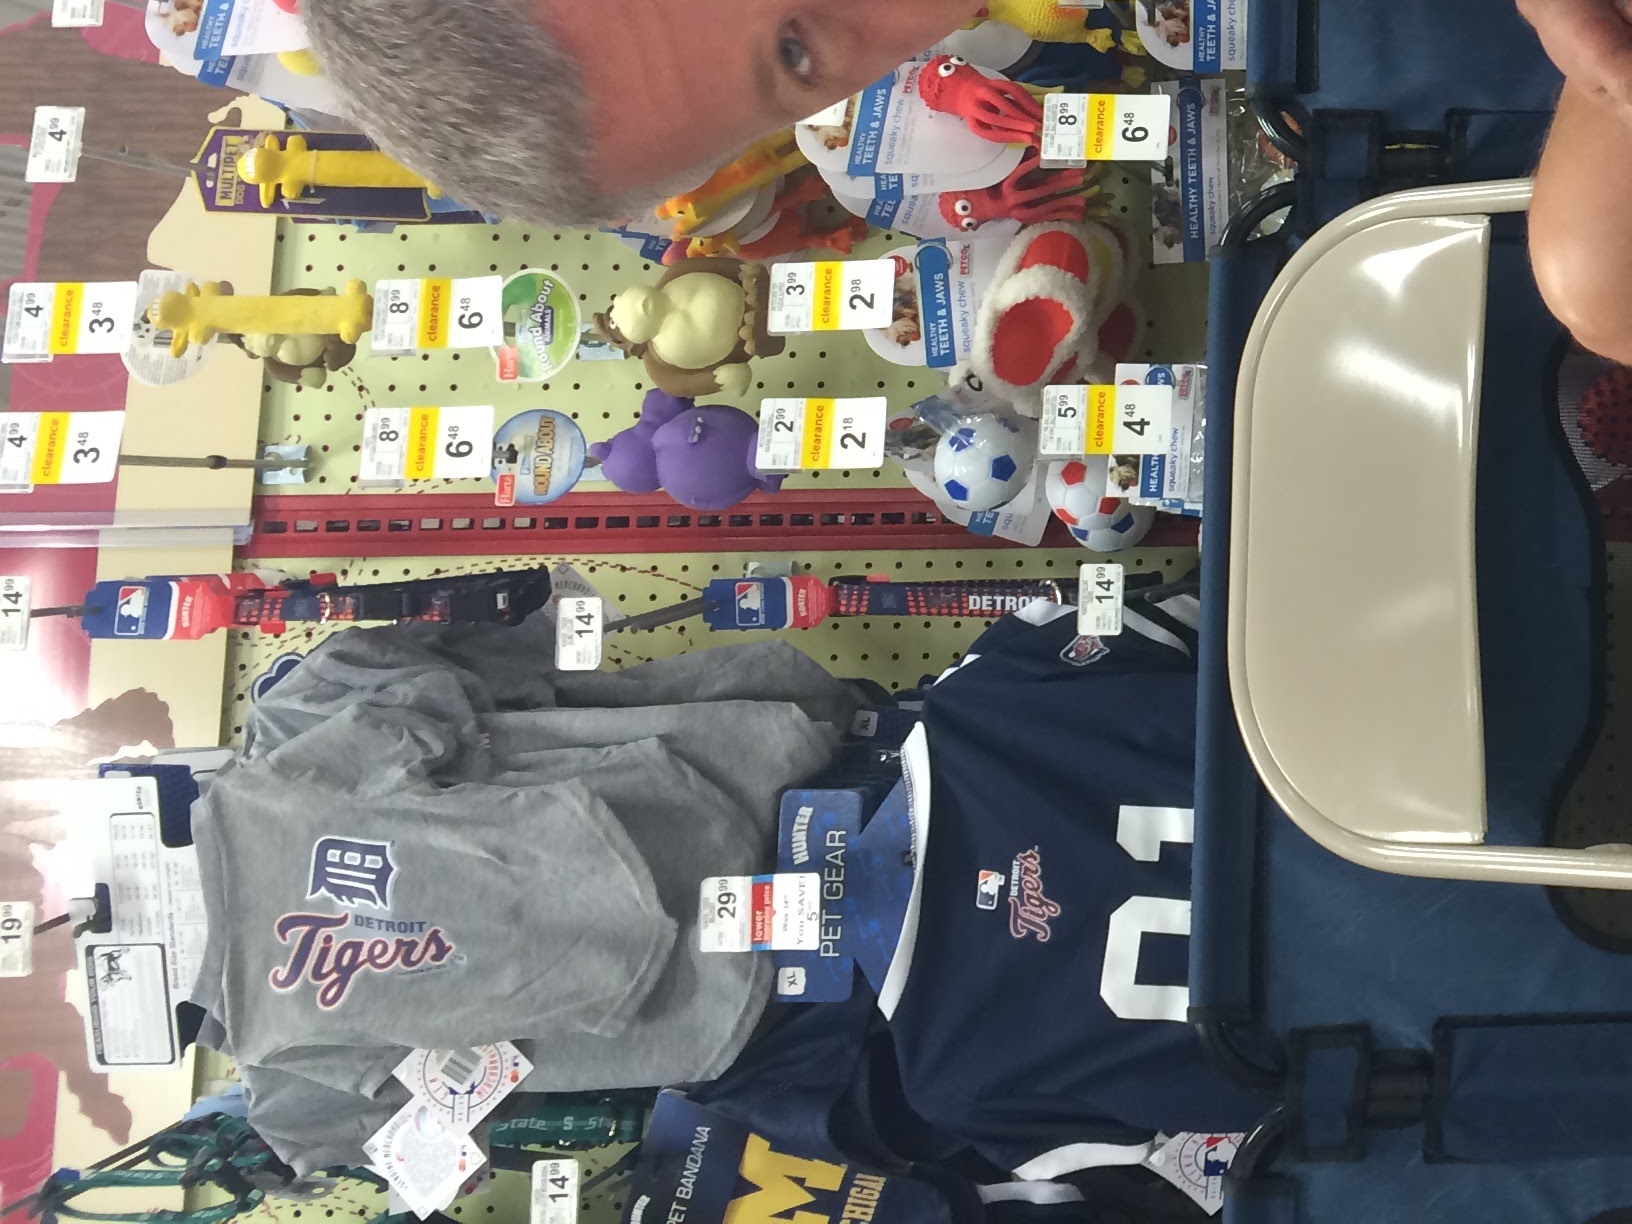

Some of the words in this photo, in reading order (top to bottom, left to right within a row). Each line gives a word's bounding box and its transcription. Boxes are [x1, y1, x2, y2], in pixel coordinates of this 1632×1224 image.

[210, 12, 227, 49] TEETH
[1198, 26, 1206, 62] HEALTHY
[1206, 24, 1217, 62] TEETH
[1226, 18, 1238, 62] squeaky
[862, 131, 879, 165] TEETH
[871, 88, 887, 119] JAWS
[890, 98, 906, 124] chew
[1093, 100, 1106, 154] clearance
[1184, 102, 1197, 134] JAWS
[853, 131, 867, 165] HEALTHY
[883, 125, 903, 166] squeaky
[1186, 148, 1198, 184] TEETH
[220, 141, 238, 201] MULTIPET
[1206, 176, 1216, 199] chew
[1187, 187, 1199, 239] HEALTHY
[1206, 201, 1217, 236] squeaky
[529, 279, 554, 322] About
[820, 268, 833, 323] clearance
[934, 272, 946, 305] JAWS
[956, 280, 967, 308] chew
[57, 289, 74, 347] clearance
[427, 284, 441, 342] clearance
[543, 308, 553, 343] ANIMALS
[957, 309, 972, 353] squeaky
[928, 322, 939, 357] HEALTHY
[937, 318, 951, 356] TEETH
[537, 414, 555, 455] ABOUT
[811, 405, 825, 462] clearance
[1094, 391, 1106, 448] clearance
[1168, 427, 1179, 452] chew
[40, 418, 60, 477] clearance
[415, 414, 430, 472] clearance
[499, 476, 512, 504] Hartz
[1168, 454, 1179, 492] squeaky
[791, 806, 814, 865] HUNTER
[823, 830, 847, 900] GEAR
[1010, 859, 1021, 897] DETROIT
[1008, 849, 1061, 942] Tigers
[353, 914, 427, 933] DETROIT
[754, 909, 763, 941] lower
[820, 908, 842, 957] PET
[267, 911, 456, 1011] Tigers
[785, 970, 798, 989] XL
[674, 1126, 712, 1200] BANDANA
